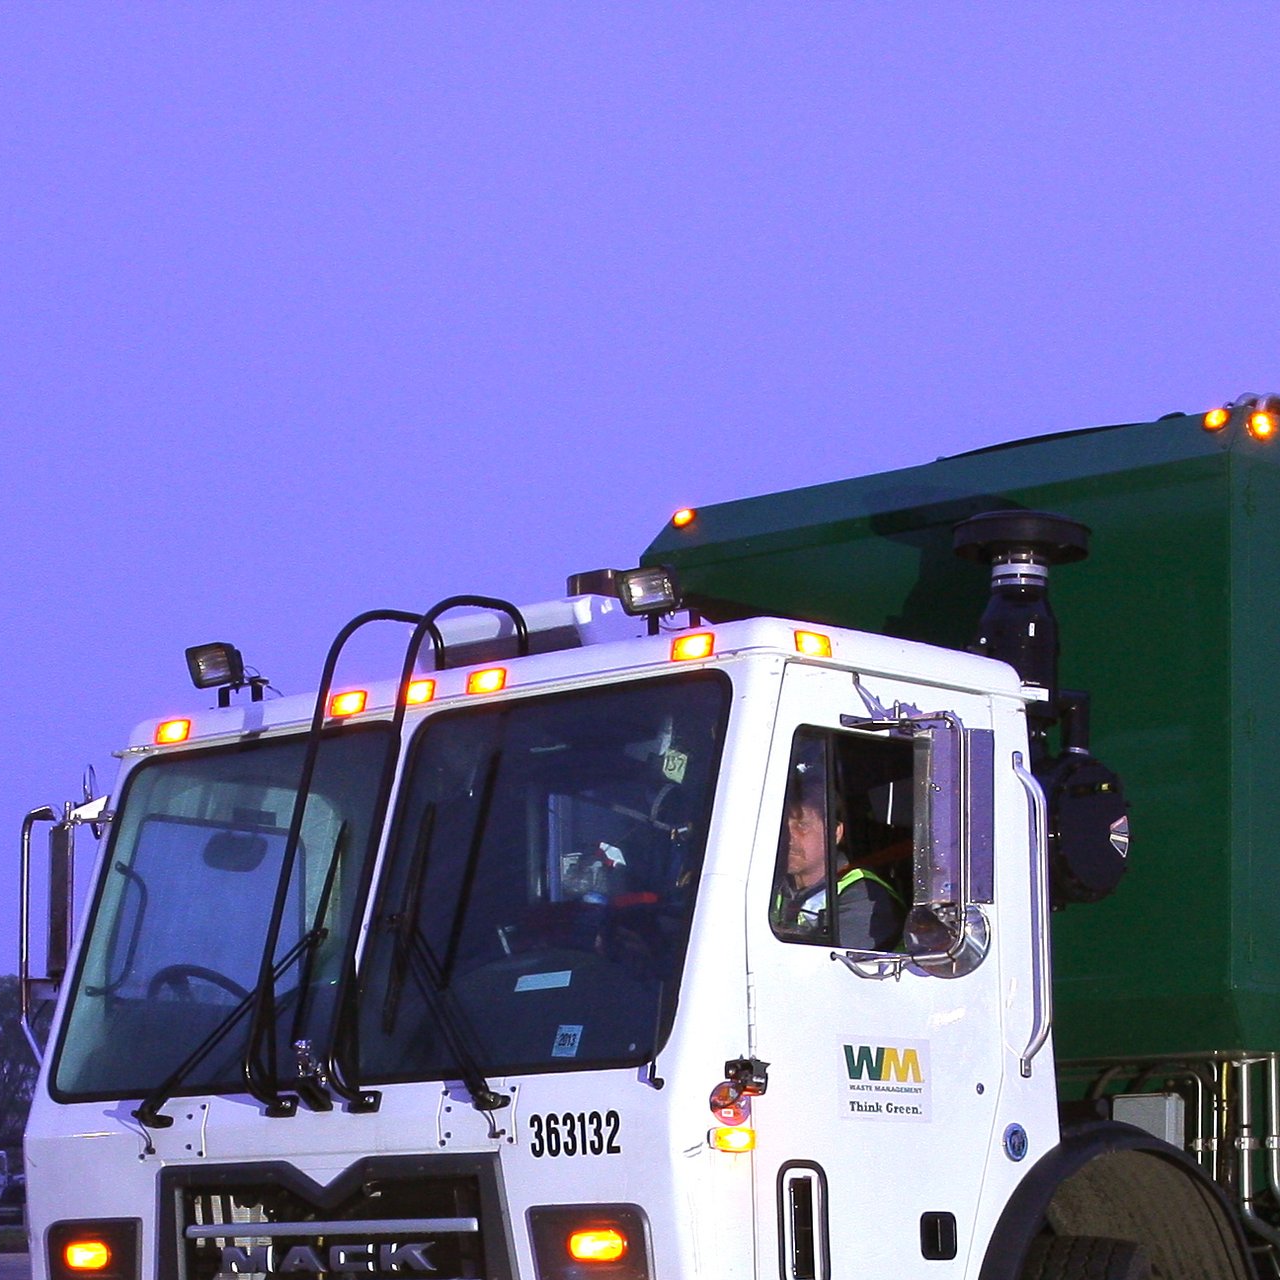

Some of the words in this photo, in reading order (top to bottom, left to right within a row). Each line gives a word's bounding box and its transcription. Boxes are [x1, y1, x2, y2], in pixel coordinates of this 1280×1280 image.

[843, 1045, 922, 1083] WM
[849, 1084, 872, 1092] WASTE
[874, 1086, 922, 1094] MANAGEMENT
[849, 1101, 882, 1114] Think
[885, 1103, 922, 1115] Green.
[529, 1110, 621, 1158] 363132
[221, 1241, 437, 1273] MACK
